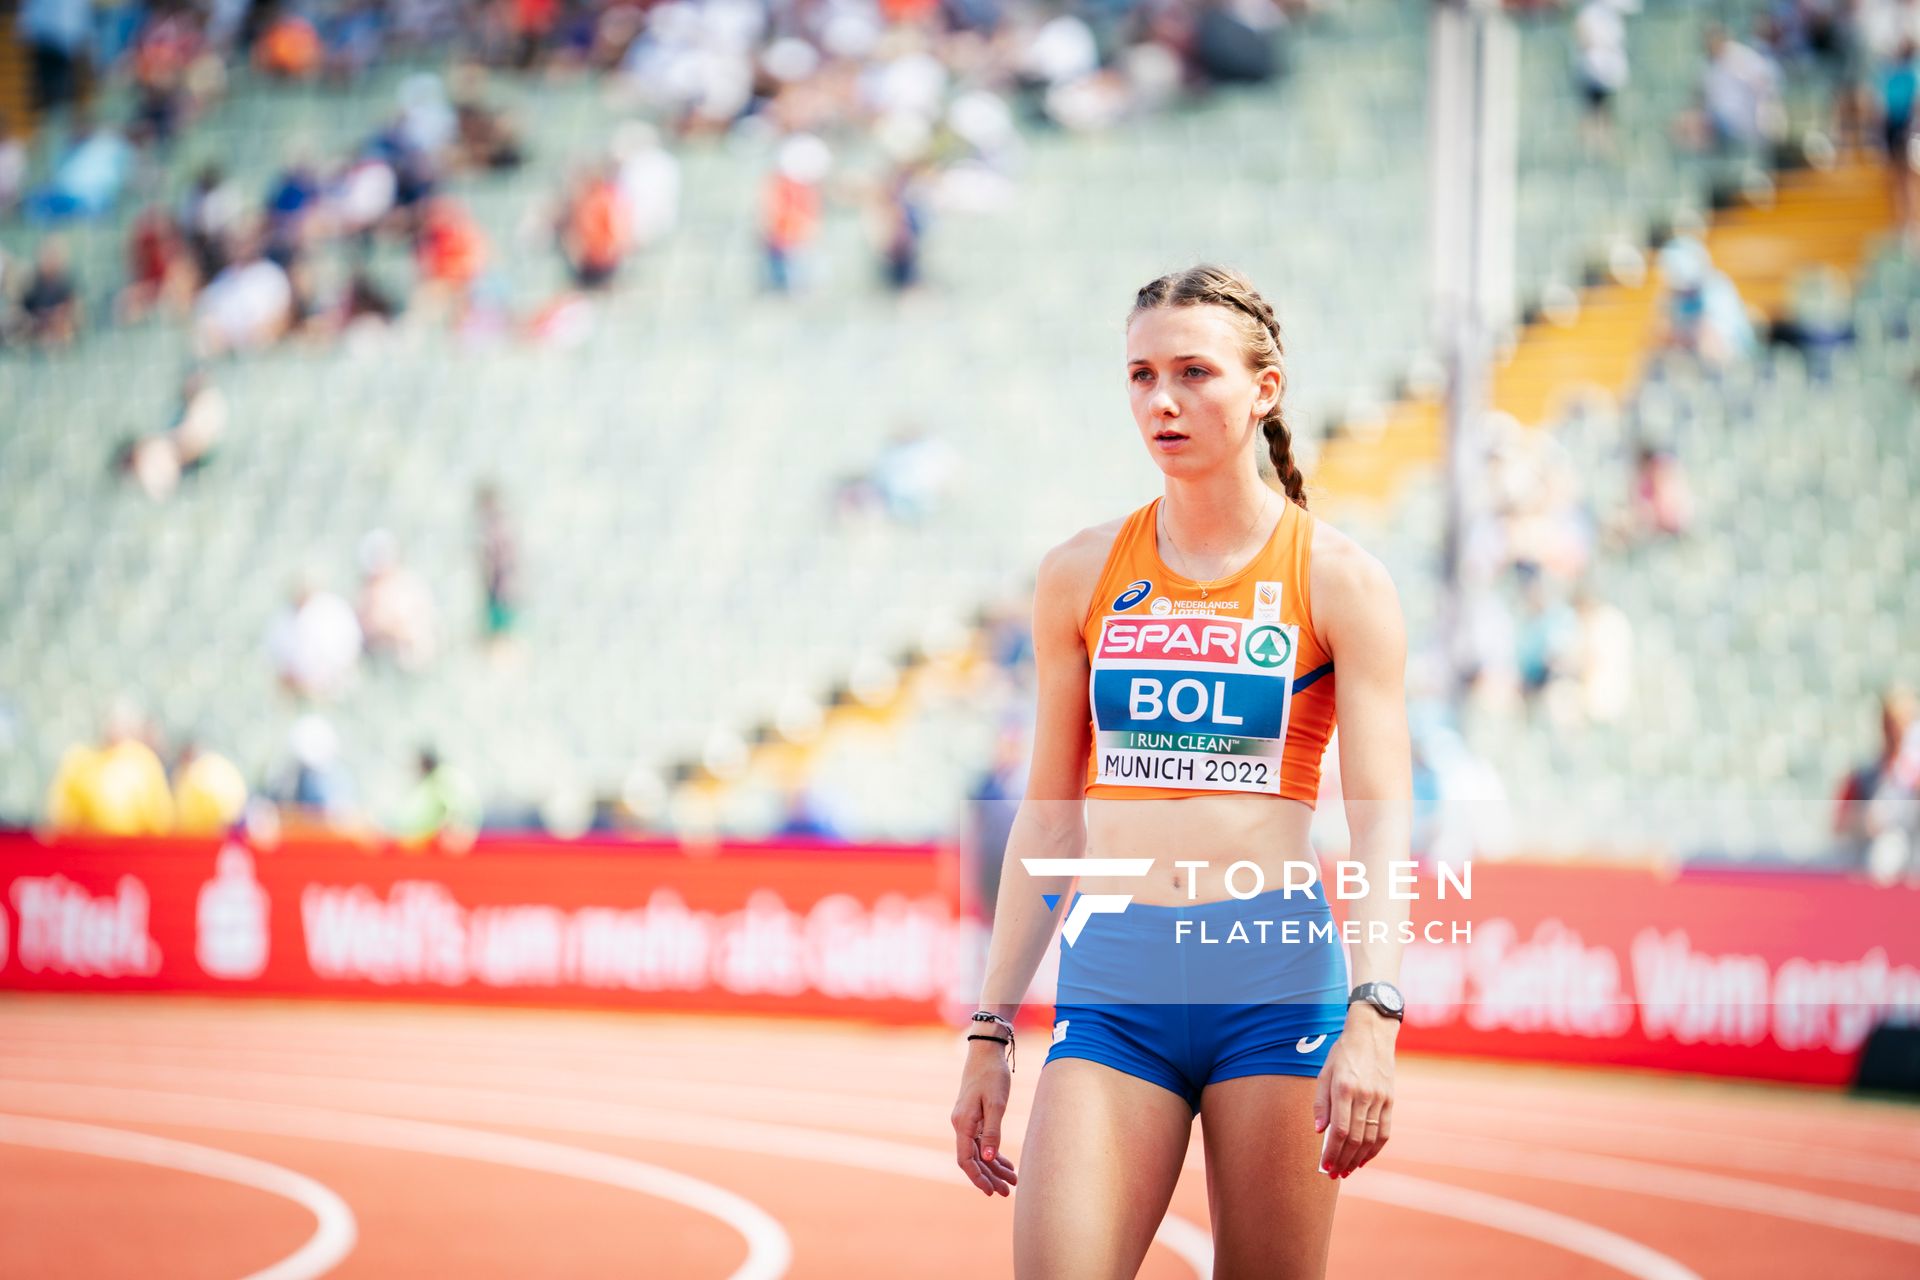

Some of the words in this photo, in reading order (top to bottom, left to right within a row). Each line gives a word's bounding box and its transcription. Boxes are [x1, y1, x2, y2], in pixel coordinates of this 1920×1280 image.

[1173, 600, 1239, 609] NEDERLANDSE
[1104, 623, 1238, 658] SPAR
[1129, 677, 1243, 726] BOL
[1130, 733, 1134, 748] I
[1137, 734, 1174, 749] RUN
[1104, 755, 1194, 781] MUNICH
[1205, 760, 1268, 785] 2022
